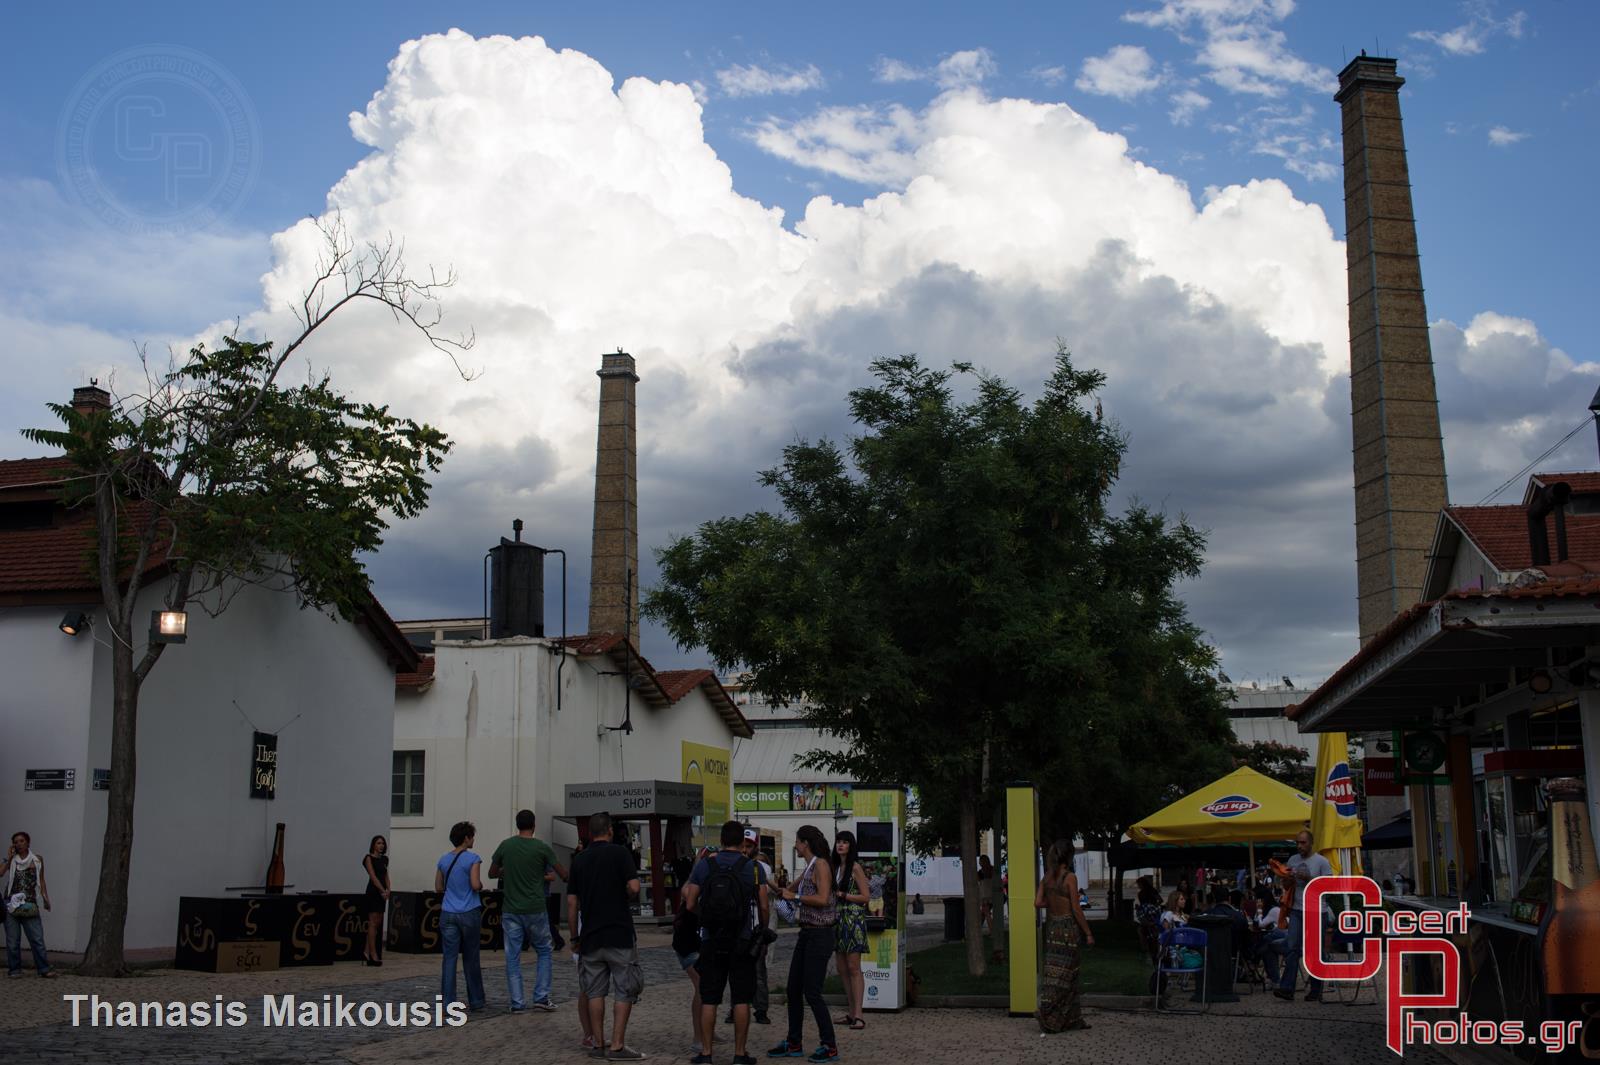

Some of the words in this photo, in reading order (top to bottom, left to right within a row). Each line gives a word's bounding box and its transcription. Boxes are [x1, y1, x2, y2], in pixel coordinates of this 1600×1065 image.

[569, 790, 606, 799] INDUSTRIAL
[608, 789, 621, 797] GAS
[623, 788, 652, 797] MUSEUM
[736, 791, 789, 802] COSMOTE
[623, 798, 652, 809] SHOP
